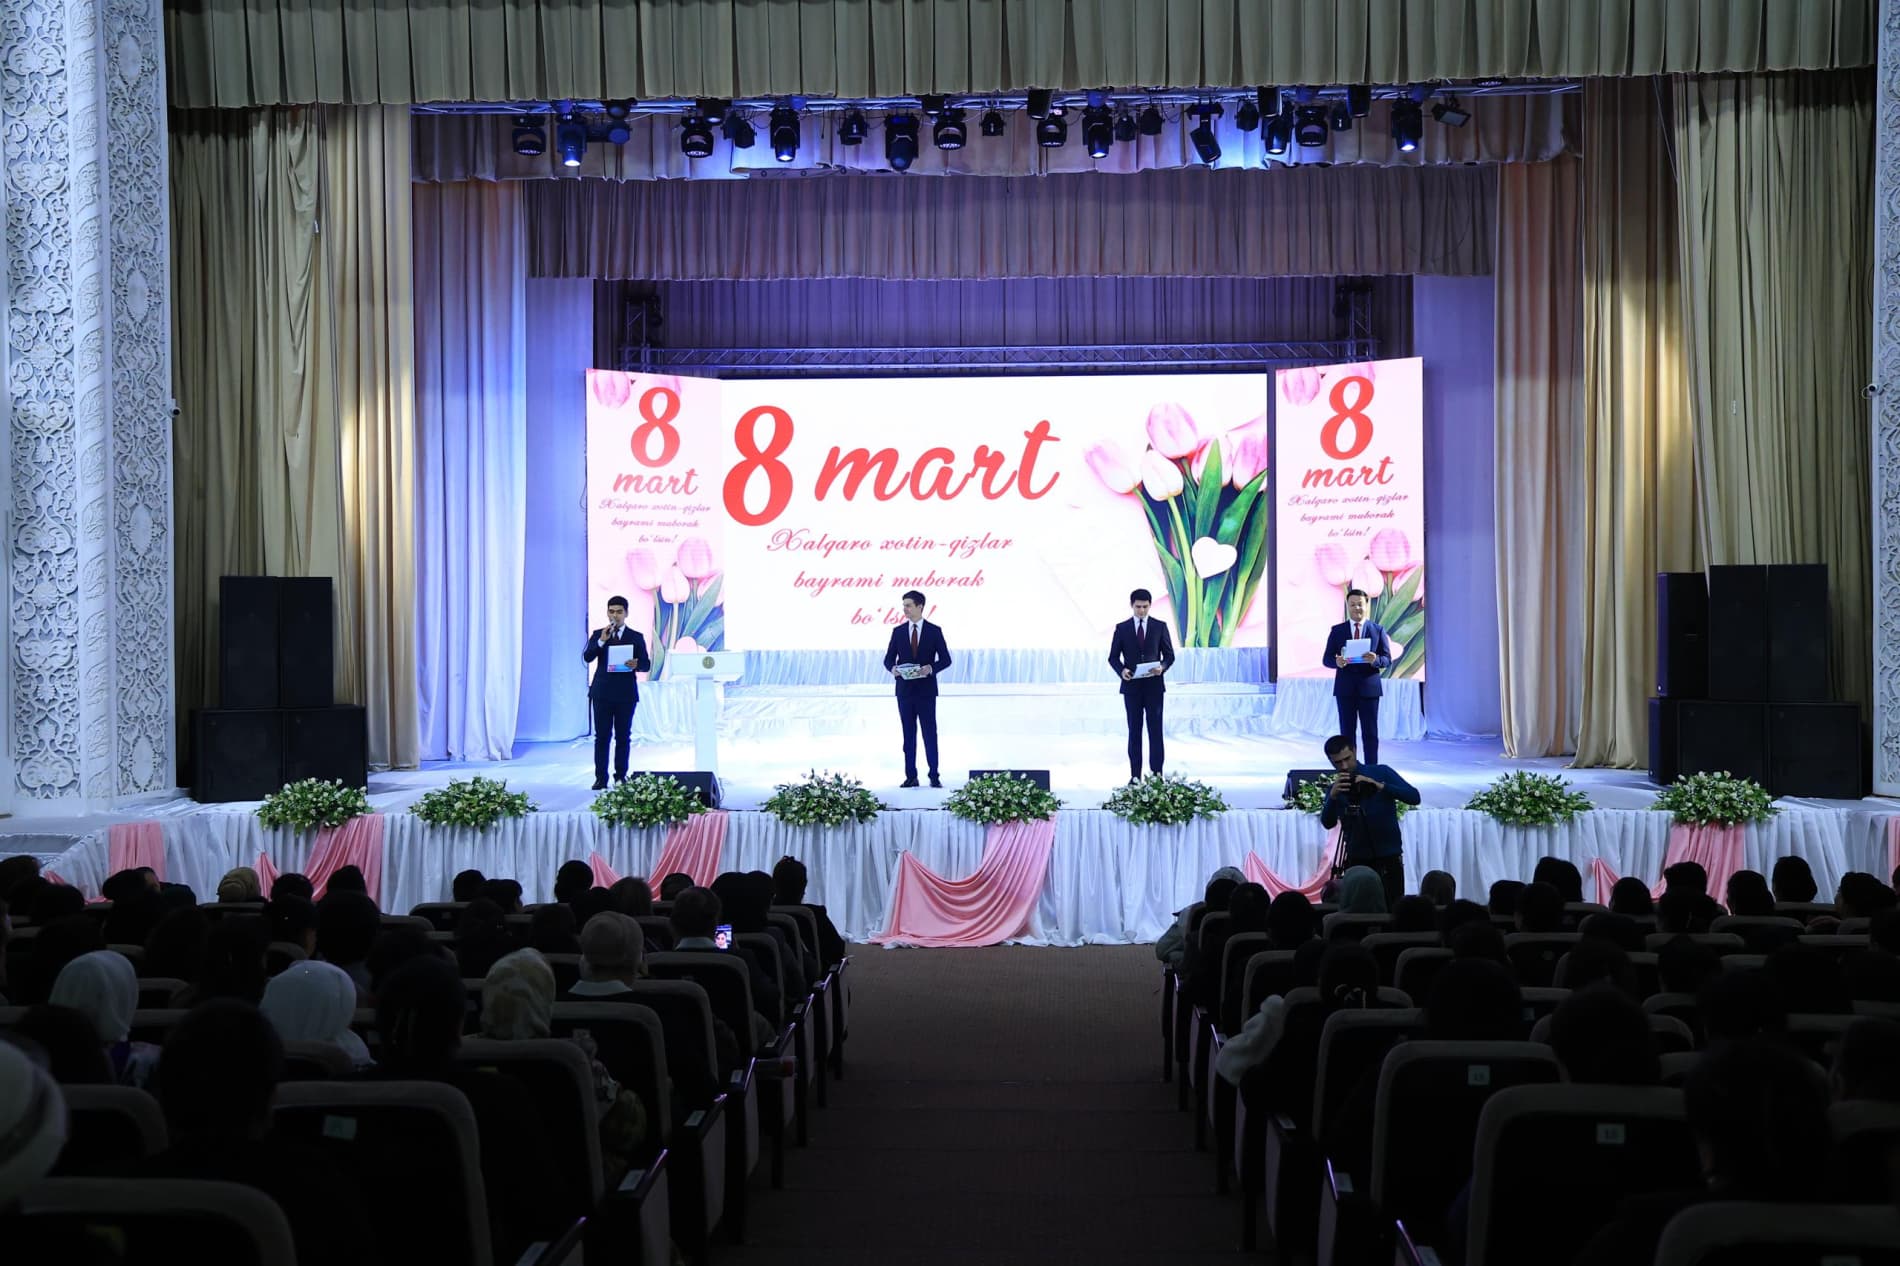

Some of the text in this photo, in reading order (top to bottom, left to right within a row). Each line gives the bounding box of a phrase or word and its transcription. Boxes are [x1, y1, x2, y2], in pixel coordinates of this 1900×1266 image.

[630, 387, 681, 468] 8
[1320, 376, 1375, 461] 8
[613, 468, 699, 496] mart
[723, 405, 1060, 527] 8 mart
[1302, 456, 1394, 489] mart
[767, 528, 1013, 559] Xalqaro xotin-qizlar
[794, 569, 985, 598] bayrami muborak
